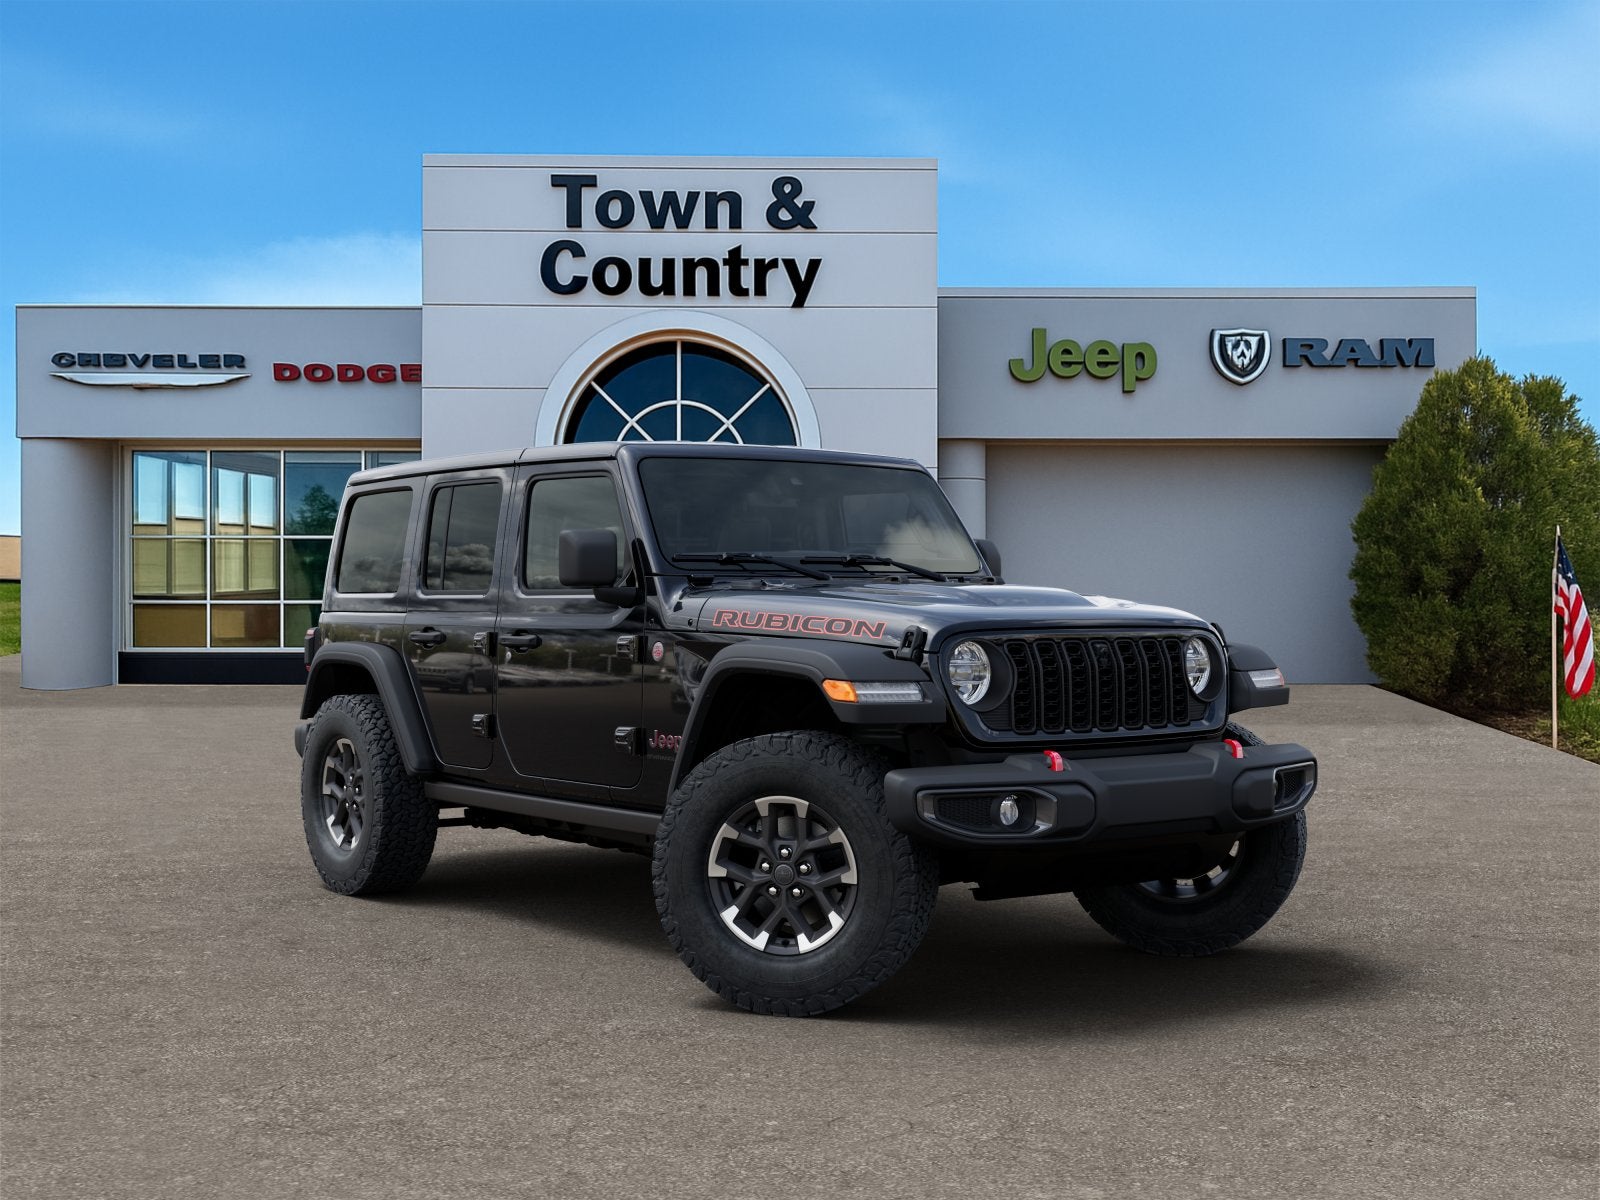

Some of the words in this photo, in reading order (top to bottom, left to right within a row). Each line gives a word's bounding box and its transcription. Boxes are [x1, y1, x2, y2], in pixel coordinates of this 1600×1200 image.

[550, 174, 743, 230] Town
[765, 175, 818, 230] &
[540, 239, 822, 308] Country
[273, 362, 422, 383] DODGE
[1009, 327, 1157, 393] Jeep
[1282, 337, 1435, 368] RAM
[712, 609, 887, 640] RUBICON
